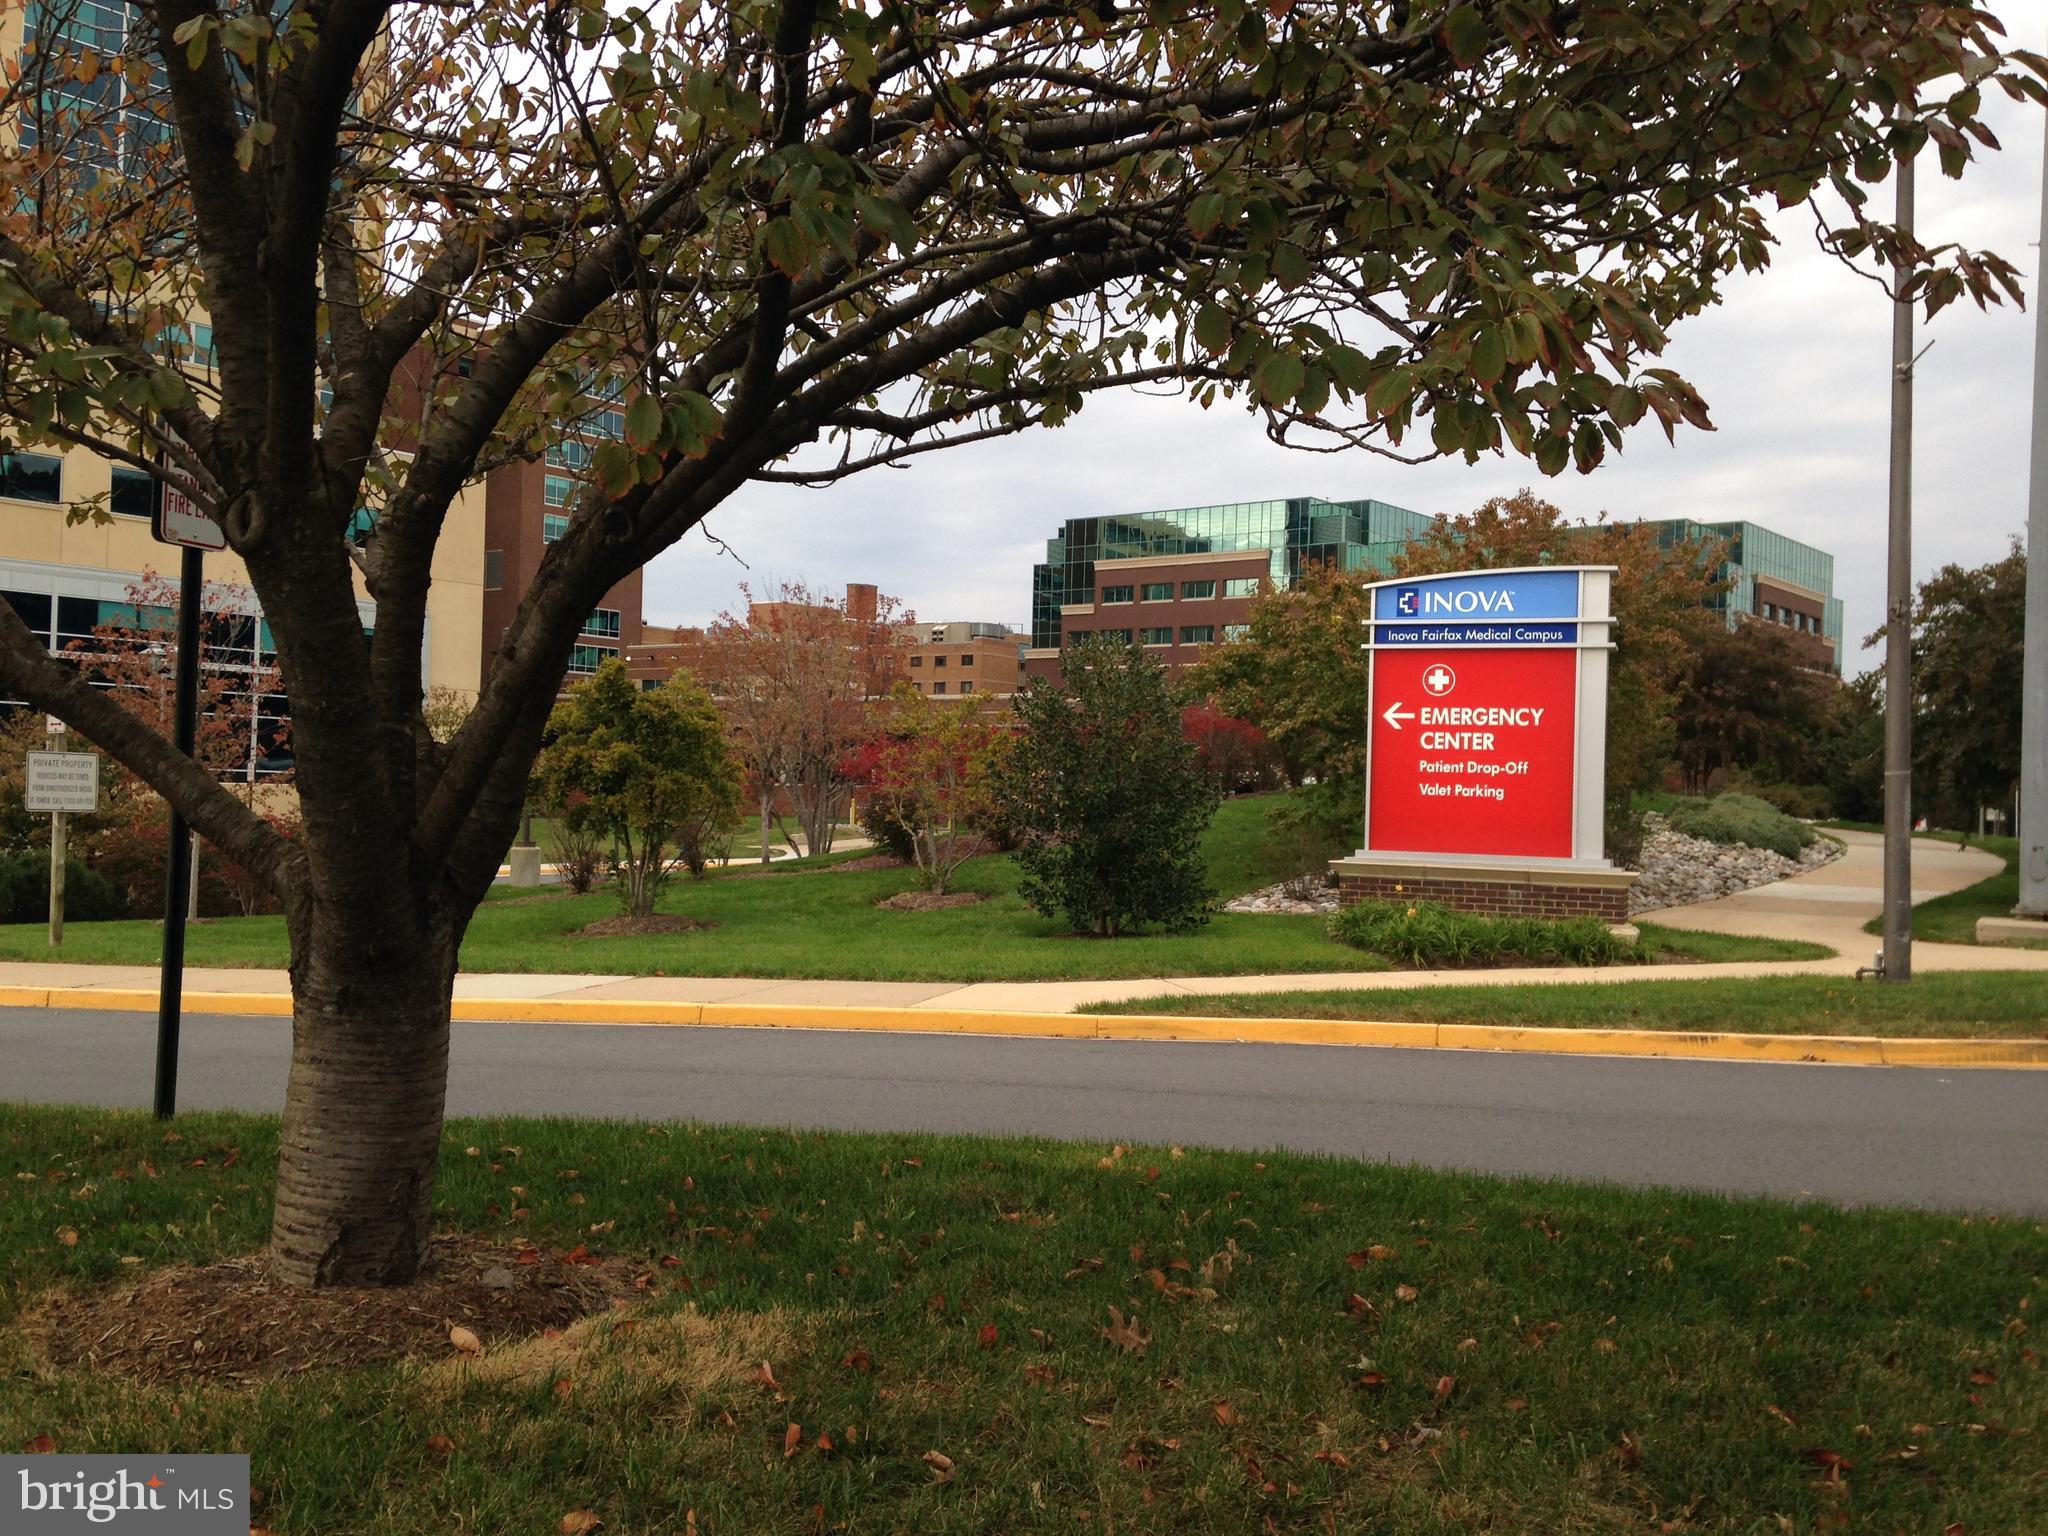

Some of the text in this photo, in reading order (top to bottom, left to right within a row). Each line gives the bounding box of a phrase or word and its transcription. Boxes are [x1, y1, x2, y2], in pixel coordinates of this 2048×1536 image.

[168, 493, 192, 516] FIRE
[1388, 629, 1563, 643] Inova Fairfax Medical Campus
[1420, 707, 1545, 726] EMERGENCY
[1420, 732, 1495, 751] CENTER
[33, 758, 92, 769] PRIVATE PROPERTY
[1419, 760, 1529, 777] Patient Drop-Off
[1419, 784, 1505, 801] Valet Parking
